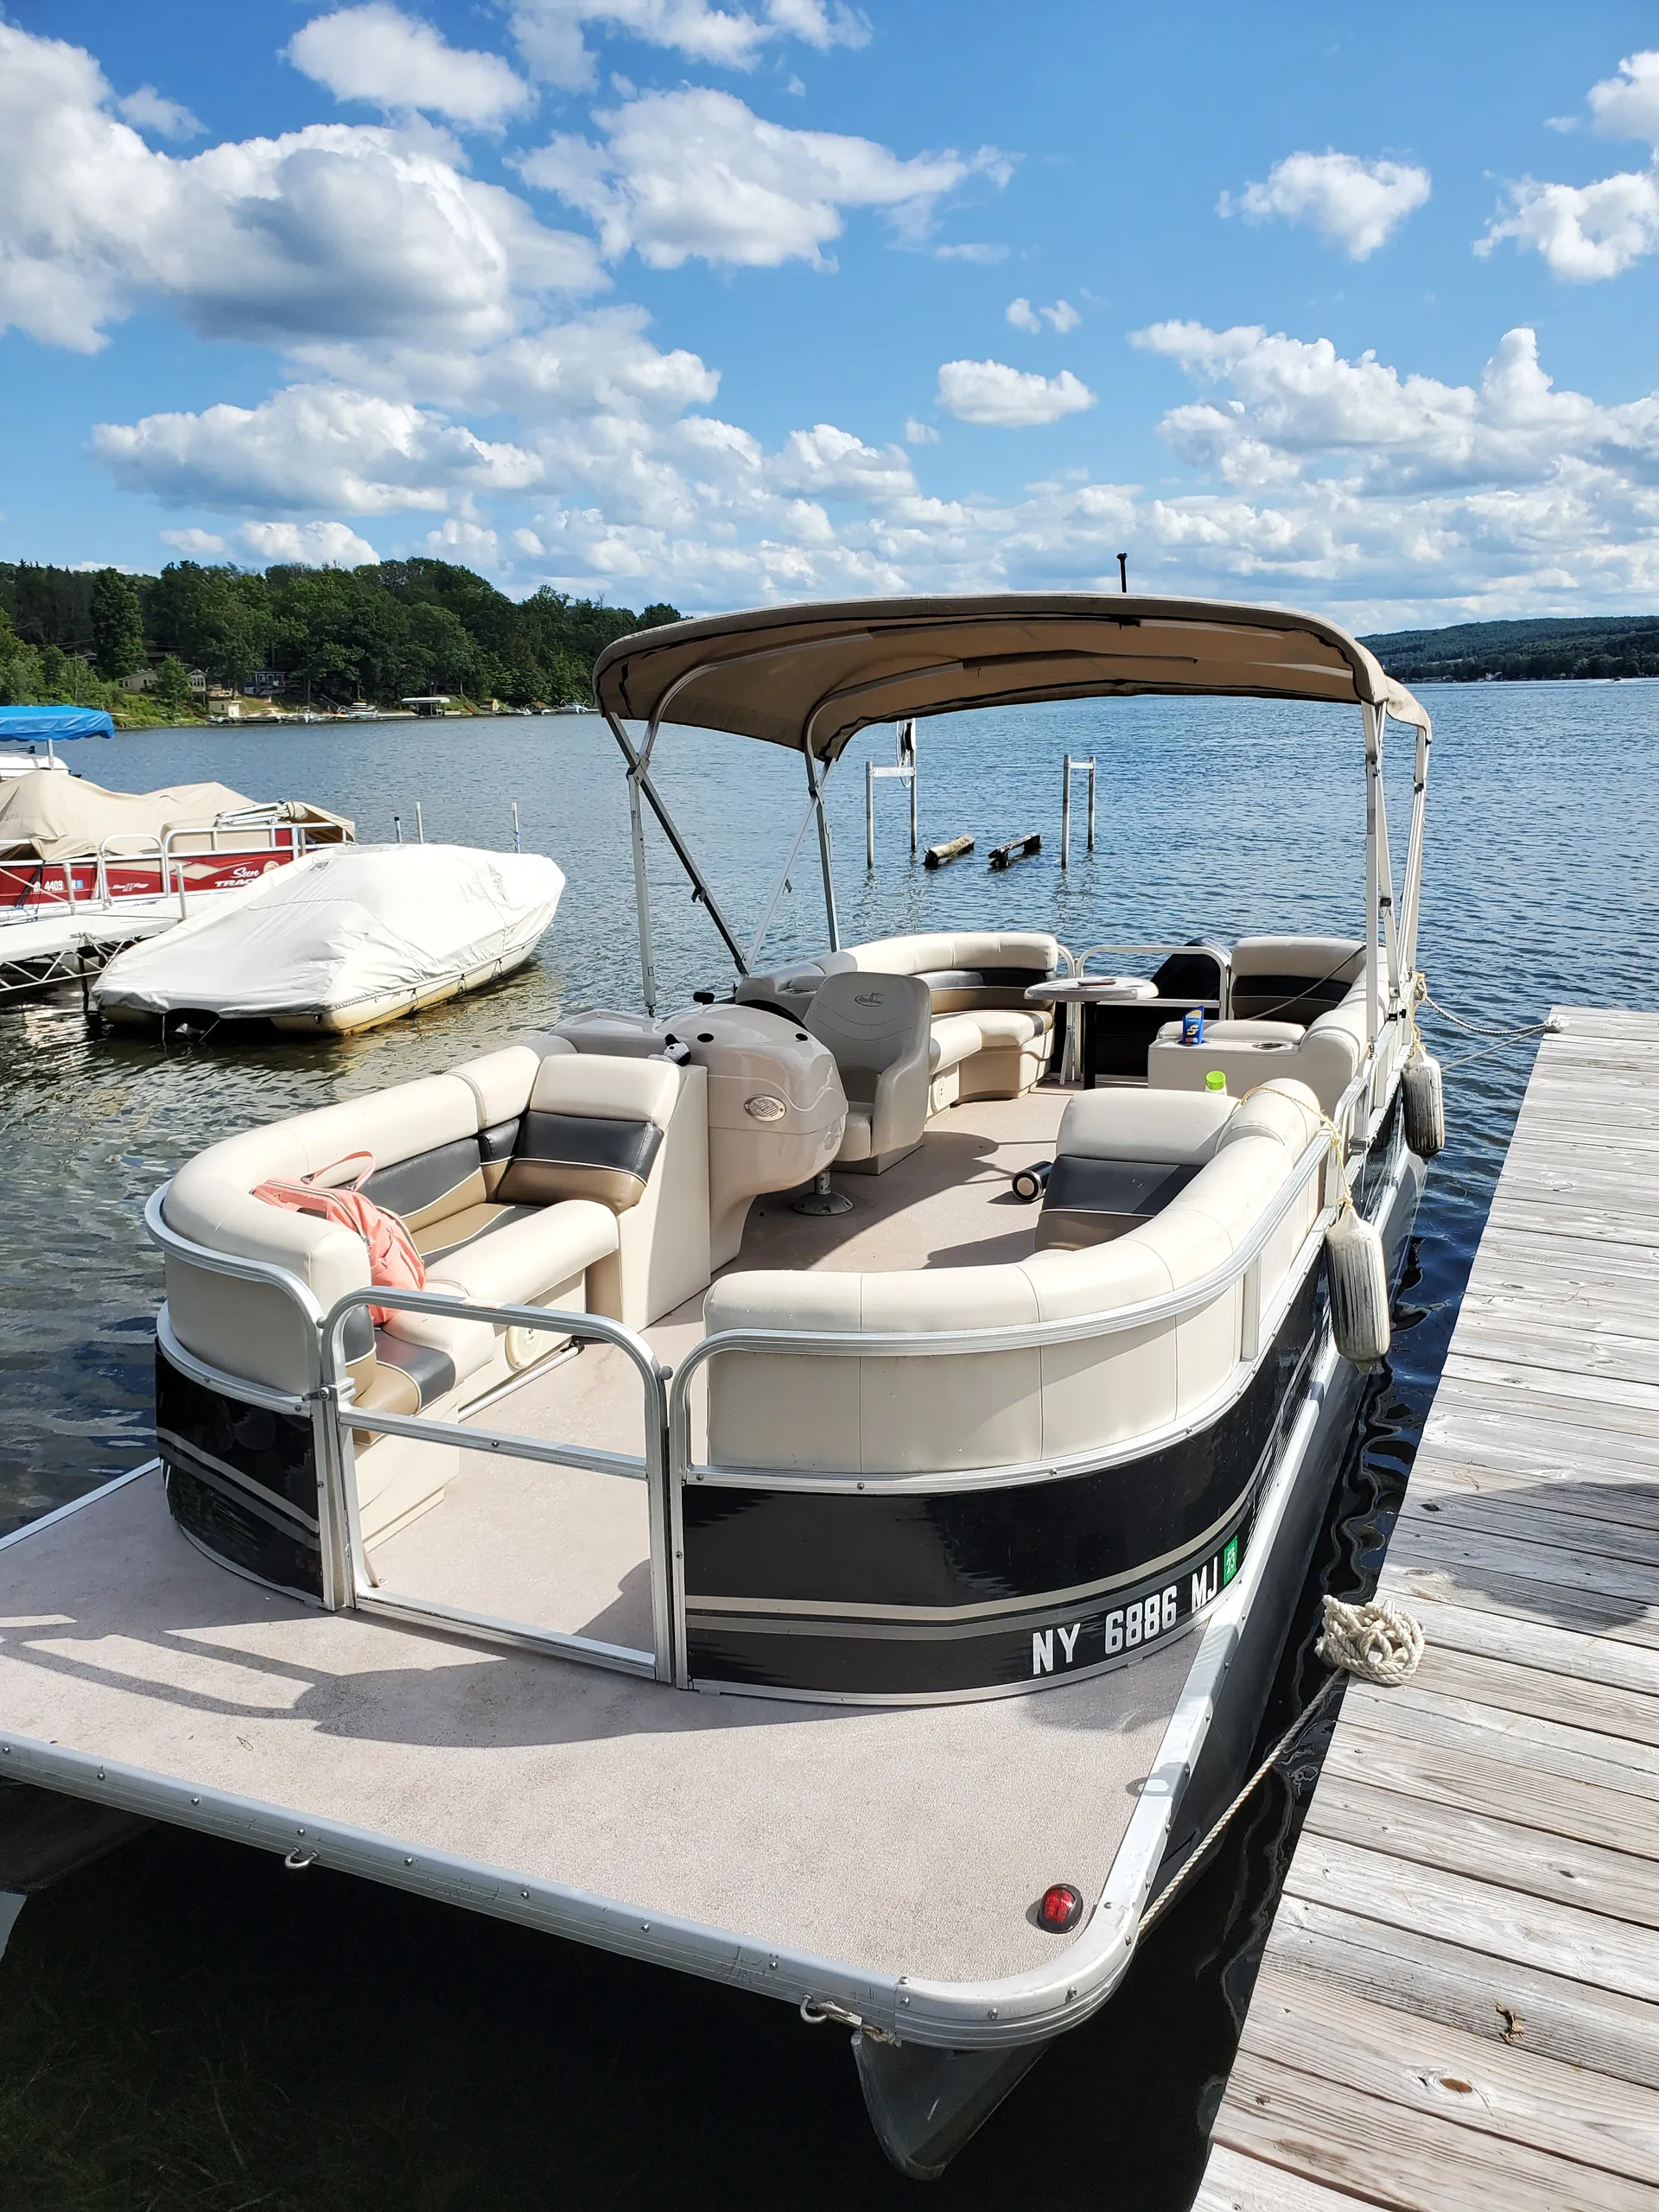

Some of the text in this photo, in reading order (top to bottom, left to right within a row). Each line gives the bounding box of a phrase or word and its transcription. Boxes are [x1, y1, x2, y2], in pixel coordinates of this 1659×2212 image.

[230, 867, 260, 879] Sun
[44, 880, 64, 892] 4409
[1033, 1555, 1218, 1675] NY 6886 MJ
